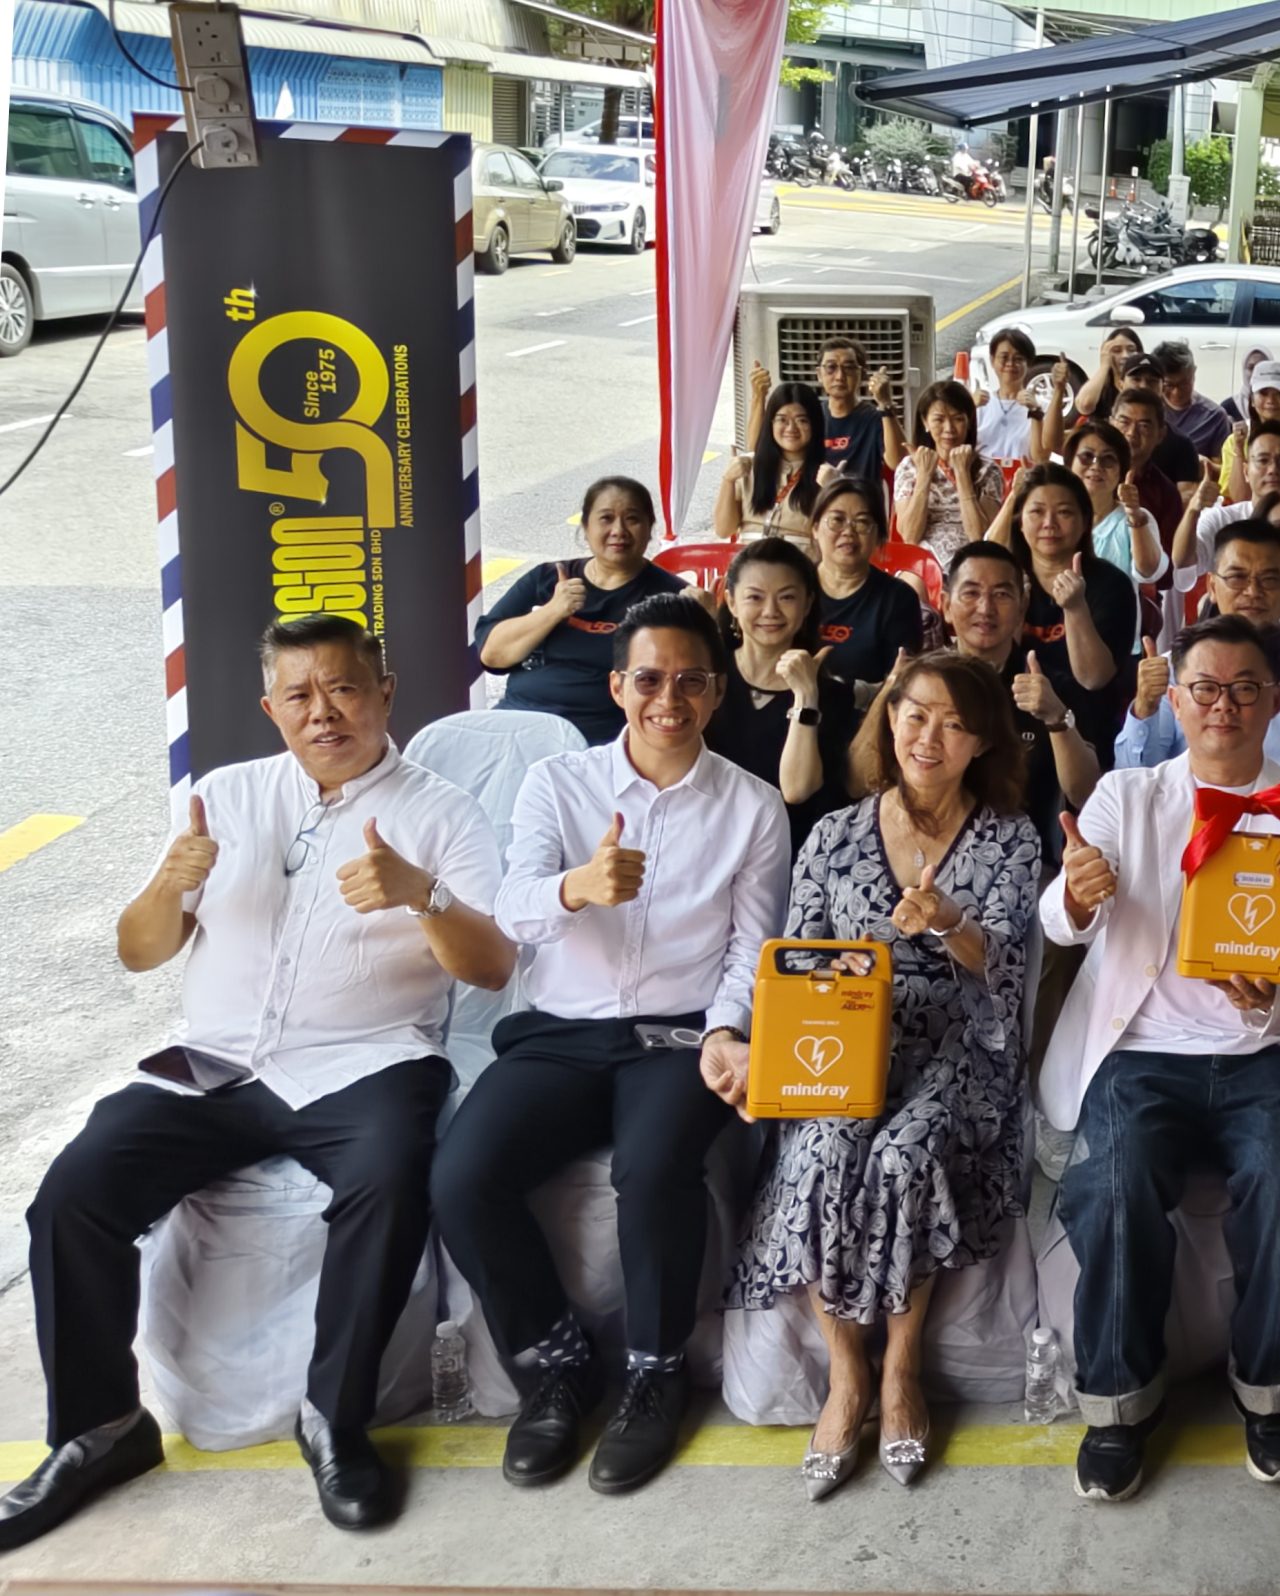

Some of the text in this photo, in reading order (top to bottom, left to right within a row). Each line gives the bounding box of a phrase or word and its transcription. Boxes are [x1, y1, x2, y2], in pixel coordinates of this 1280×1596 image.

[224, 287, 256, 322] th
[319, 348, 337, 394] 1975
[304, 370, 320, 419] Since
[394, 344, 414, 528] ANNIVERSARY CELEBRATIONS
[371, 529, 382, 554] BHD
[372, 557, 383, 582] SDN
[373, 583, 386, 637] TRADING
[1214, 940, 1280, 961] mindray
[781, 1082, 849, 1100] mindray
